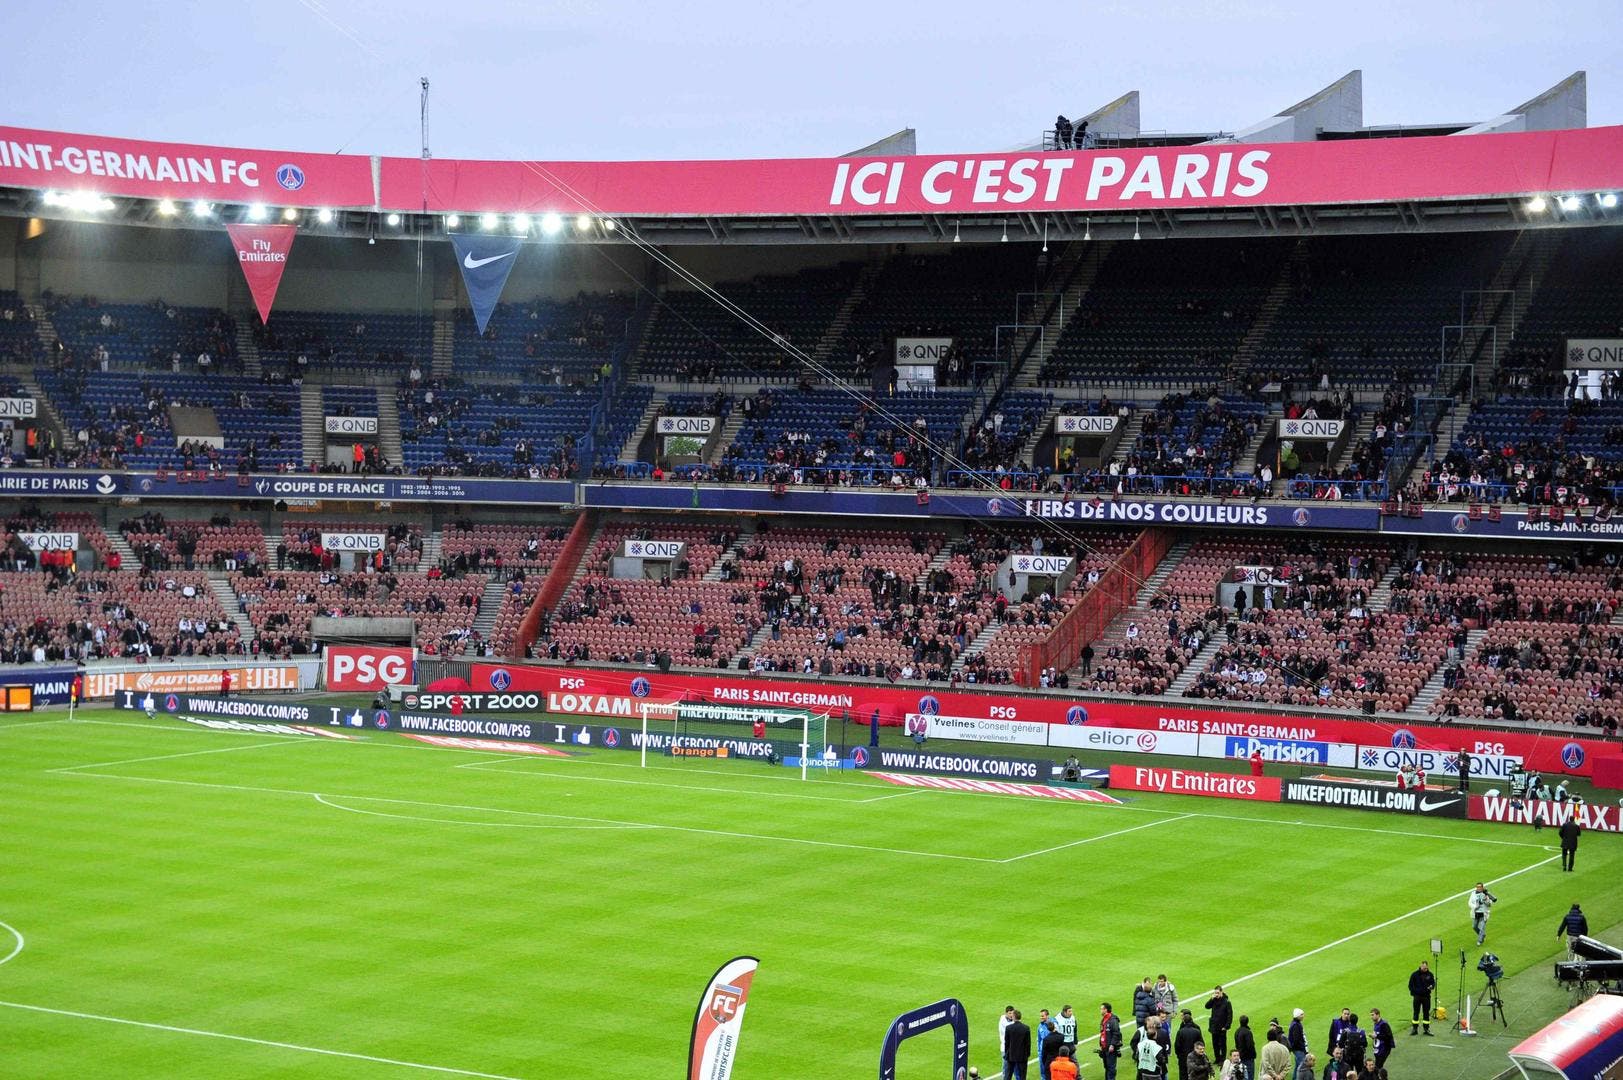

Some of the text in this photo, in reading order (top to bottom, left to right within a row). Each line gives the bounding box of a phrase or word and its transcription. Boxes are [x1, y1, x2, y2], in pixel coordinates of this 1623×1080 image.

[0, 140, 259, 187] INT-GERMAIN FC
[830, 150, 1271, 205] ICI C'EST PARIS
[253, 239, 271, 251] Fly
[239, 251, 286, 262] Emirates
[342, 418, 377, 432] QNB
[677, 419, 711, 432] QNB
[1078, 418, 1113, 431] QNB
[1302, 422, 1339, 436] QNB
[0, 477, 89, 490] IRIE DE PARIS
[274, 482, 385, 494] COUPE DE FRANCE
[1026, 500, 1268, 525] FIERS DE NOS COULEURS
[1517, 520, 1551, 532] PARIS
[38, 533, 74, 549] QNB
[344, 536, 380, 549] QNB
[645, 542, 680, 556] QNB
[333, 654, 407, 685] PSG
[91, 674, 132, 697] JBL
[247, 666, 294, 690] JBL
[34, 681, 69, 695] MAIN
[124, 691, 134, 709] I
[487, 694, 539, 709] 2000
[550, 693, 632, 716] LOXAM
[714, 687, 853, 707] PARIS SAINT-GERMAIN
[188, 698, 309, 720] WWW.FACEBOOK.COM/PSG
[330, 708, 340, 725] I
[990, 705, 1017, 719] PSG
[401, 715, 531, 738] WWW.FACEBOOK.COM/PSG
[555, 725, 565, 742] I
[934, 718, 1044, 733] Yvelines Conseil général
[1159, 718, 1316, 741] PARIS SAINT-GERMAIN
[959, 732, 1016, 741] www.yvelines.fr
[1089, 731, 1133, 746] elior
[672, 746, 713, 757] Orange
[1234, 738, 1319, 763] le Parisien
[1474, 741, 1505, 755] PSG
[881, 752, 1037, 777] WWW.FACEBOOK.COM/PSG
[1383, 750, 1435, 770] QNB
[1136, 768, 1256, 795] Fly Emirates
[1288, 783, 1415, 811] NIKEFOOTBALL.COM
[712, 994, 737, 1014] FC
